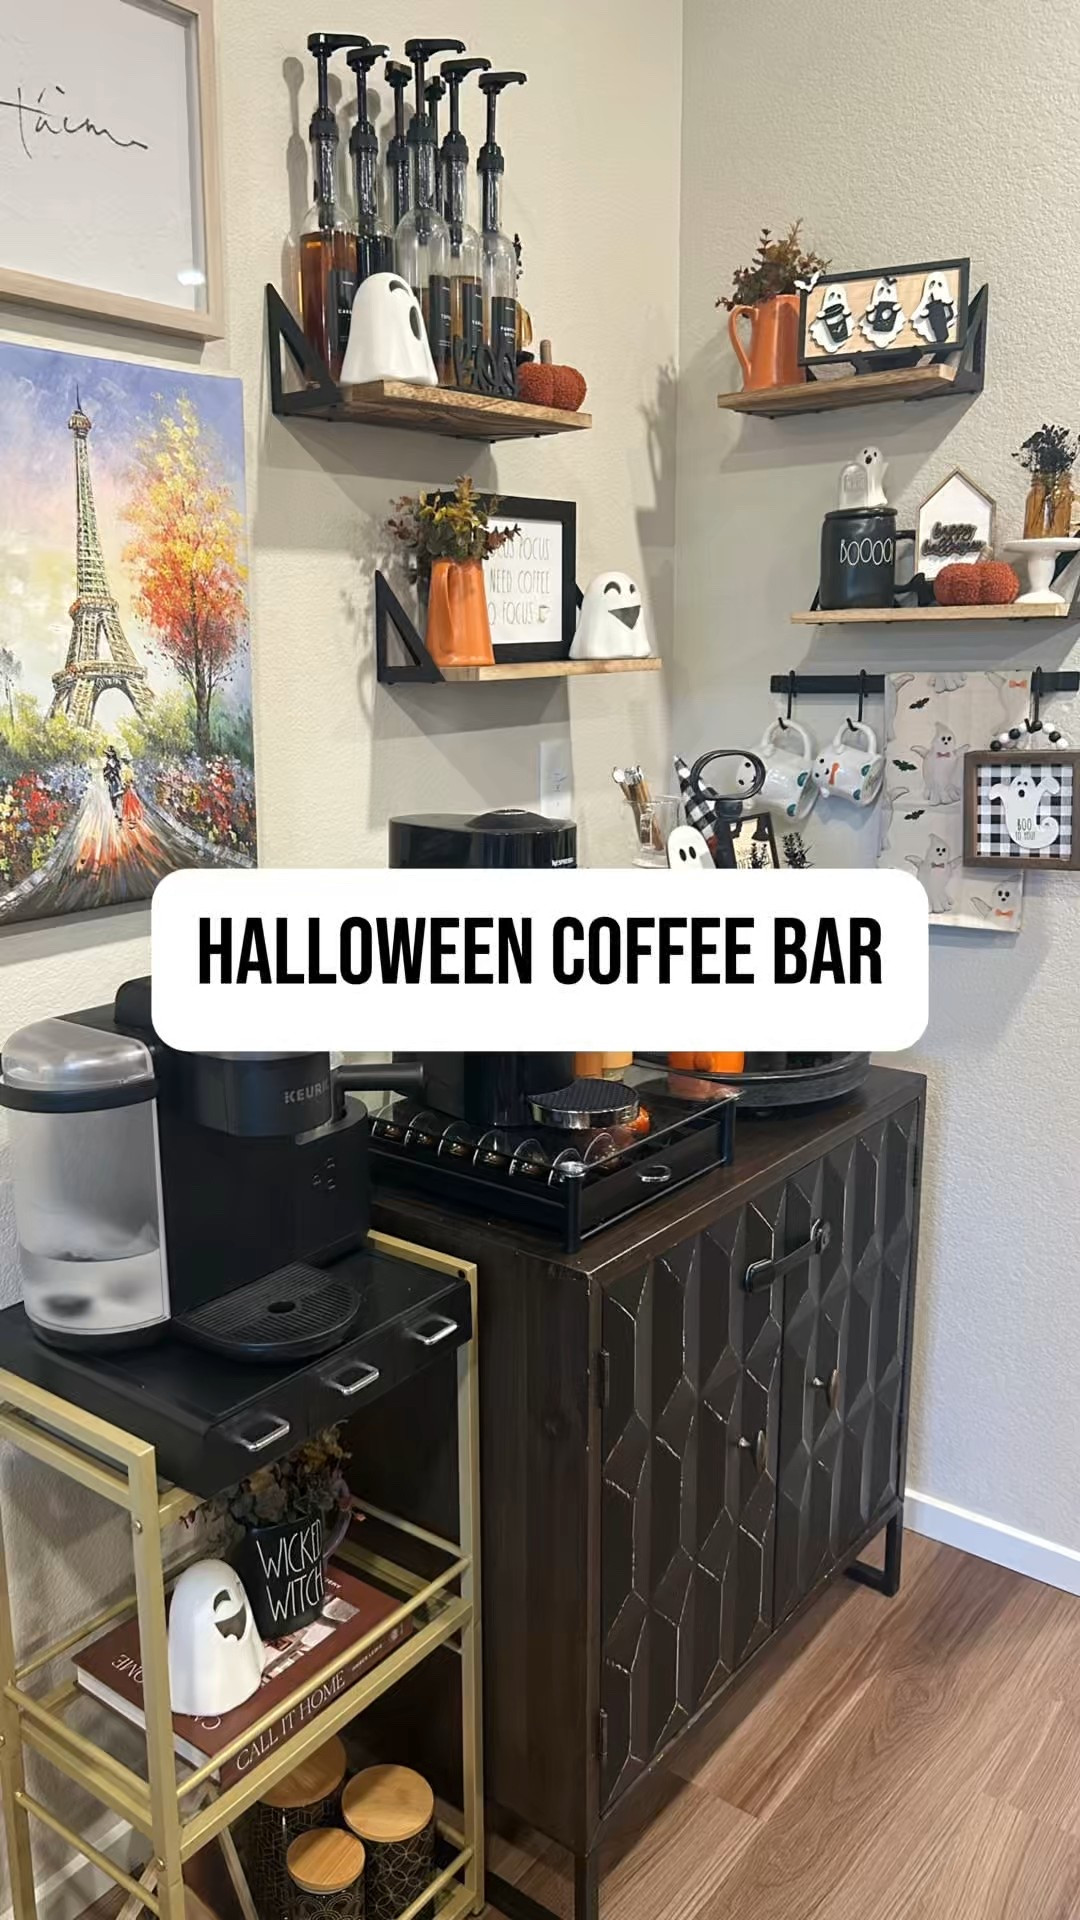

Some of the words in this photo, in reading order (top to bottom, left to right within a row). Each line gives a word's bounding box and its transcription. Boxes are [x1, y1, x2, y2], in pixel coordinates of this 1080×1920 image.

[489, 568, 513, 593] NEED
[517, 569, 550, 594] COFFEE
[502, 601, 534, 625] FOCUS
[1016, 818, 1032, 831] BOO
[255, 1518, 323, 1579] WICKED
[265, 1564, 325, 1624] WITCH
[235, 1727, 279, 1771] CALL
[281, 1712, 297, 1737] IT
[298, 1668, 346, 1721] HOME
